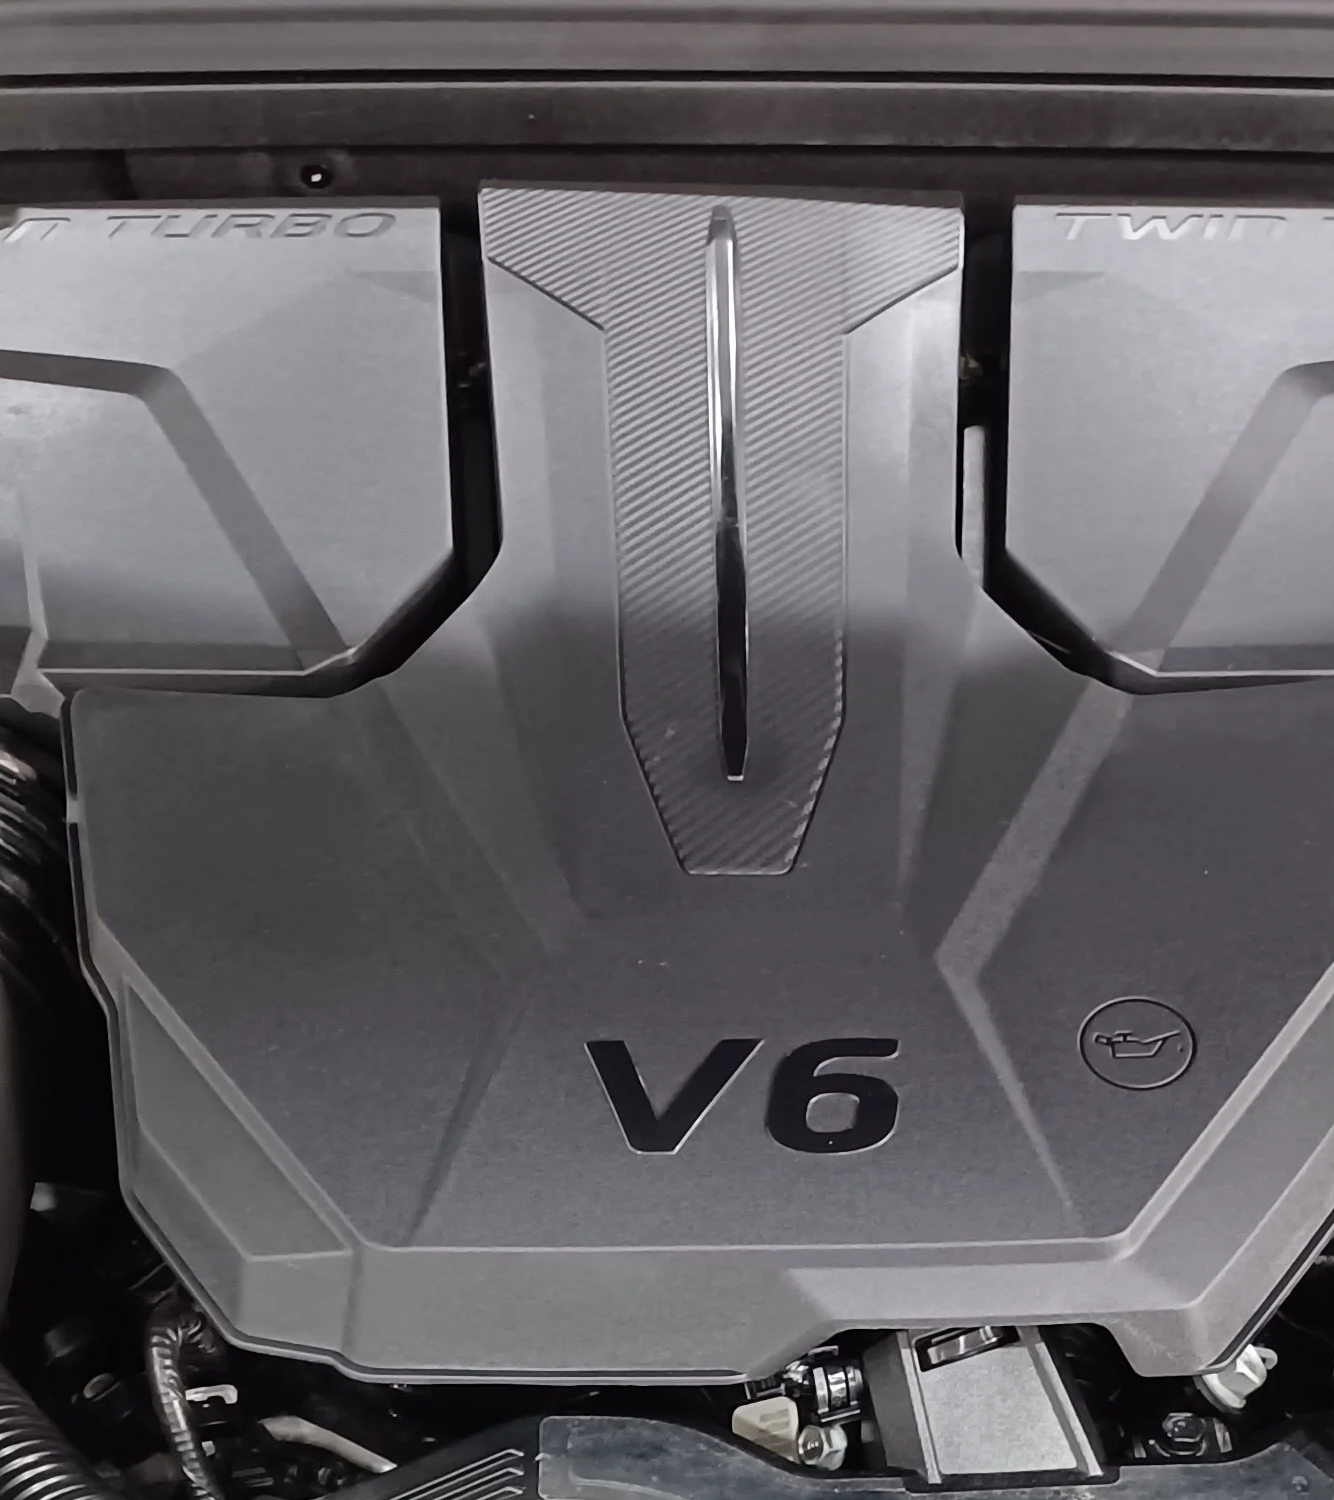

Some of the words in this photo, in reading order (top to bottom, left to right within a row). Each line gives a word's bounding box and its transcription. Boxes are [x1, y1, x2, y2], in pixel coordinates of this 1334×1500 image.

[107, 212, 397, 239] TURBO
[1056, 212, 1287, 240] TWIN
[585, 1036, 900, 1155] V6
